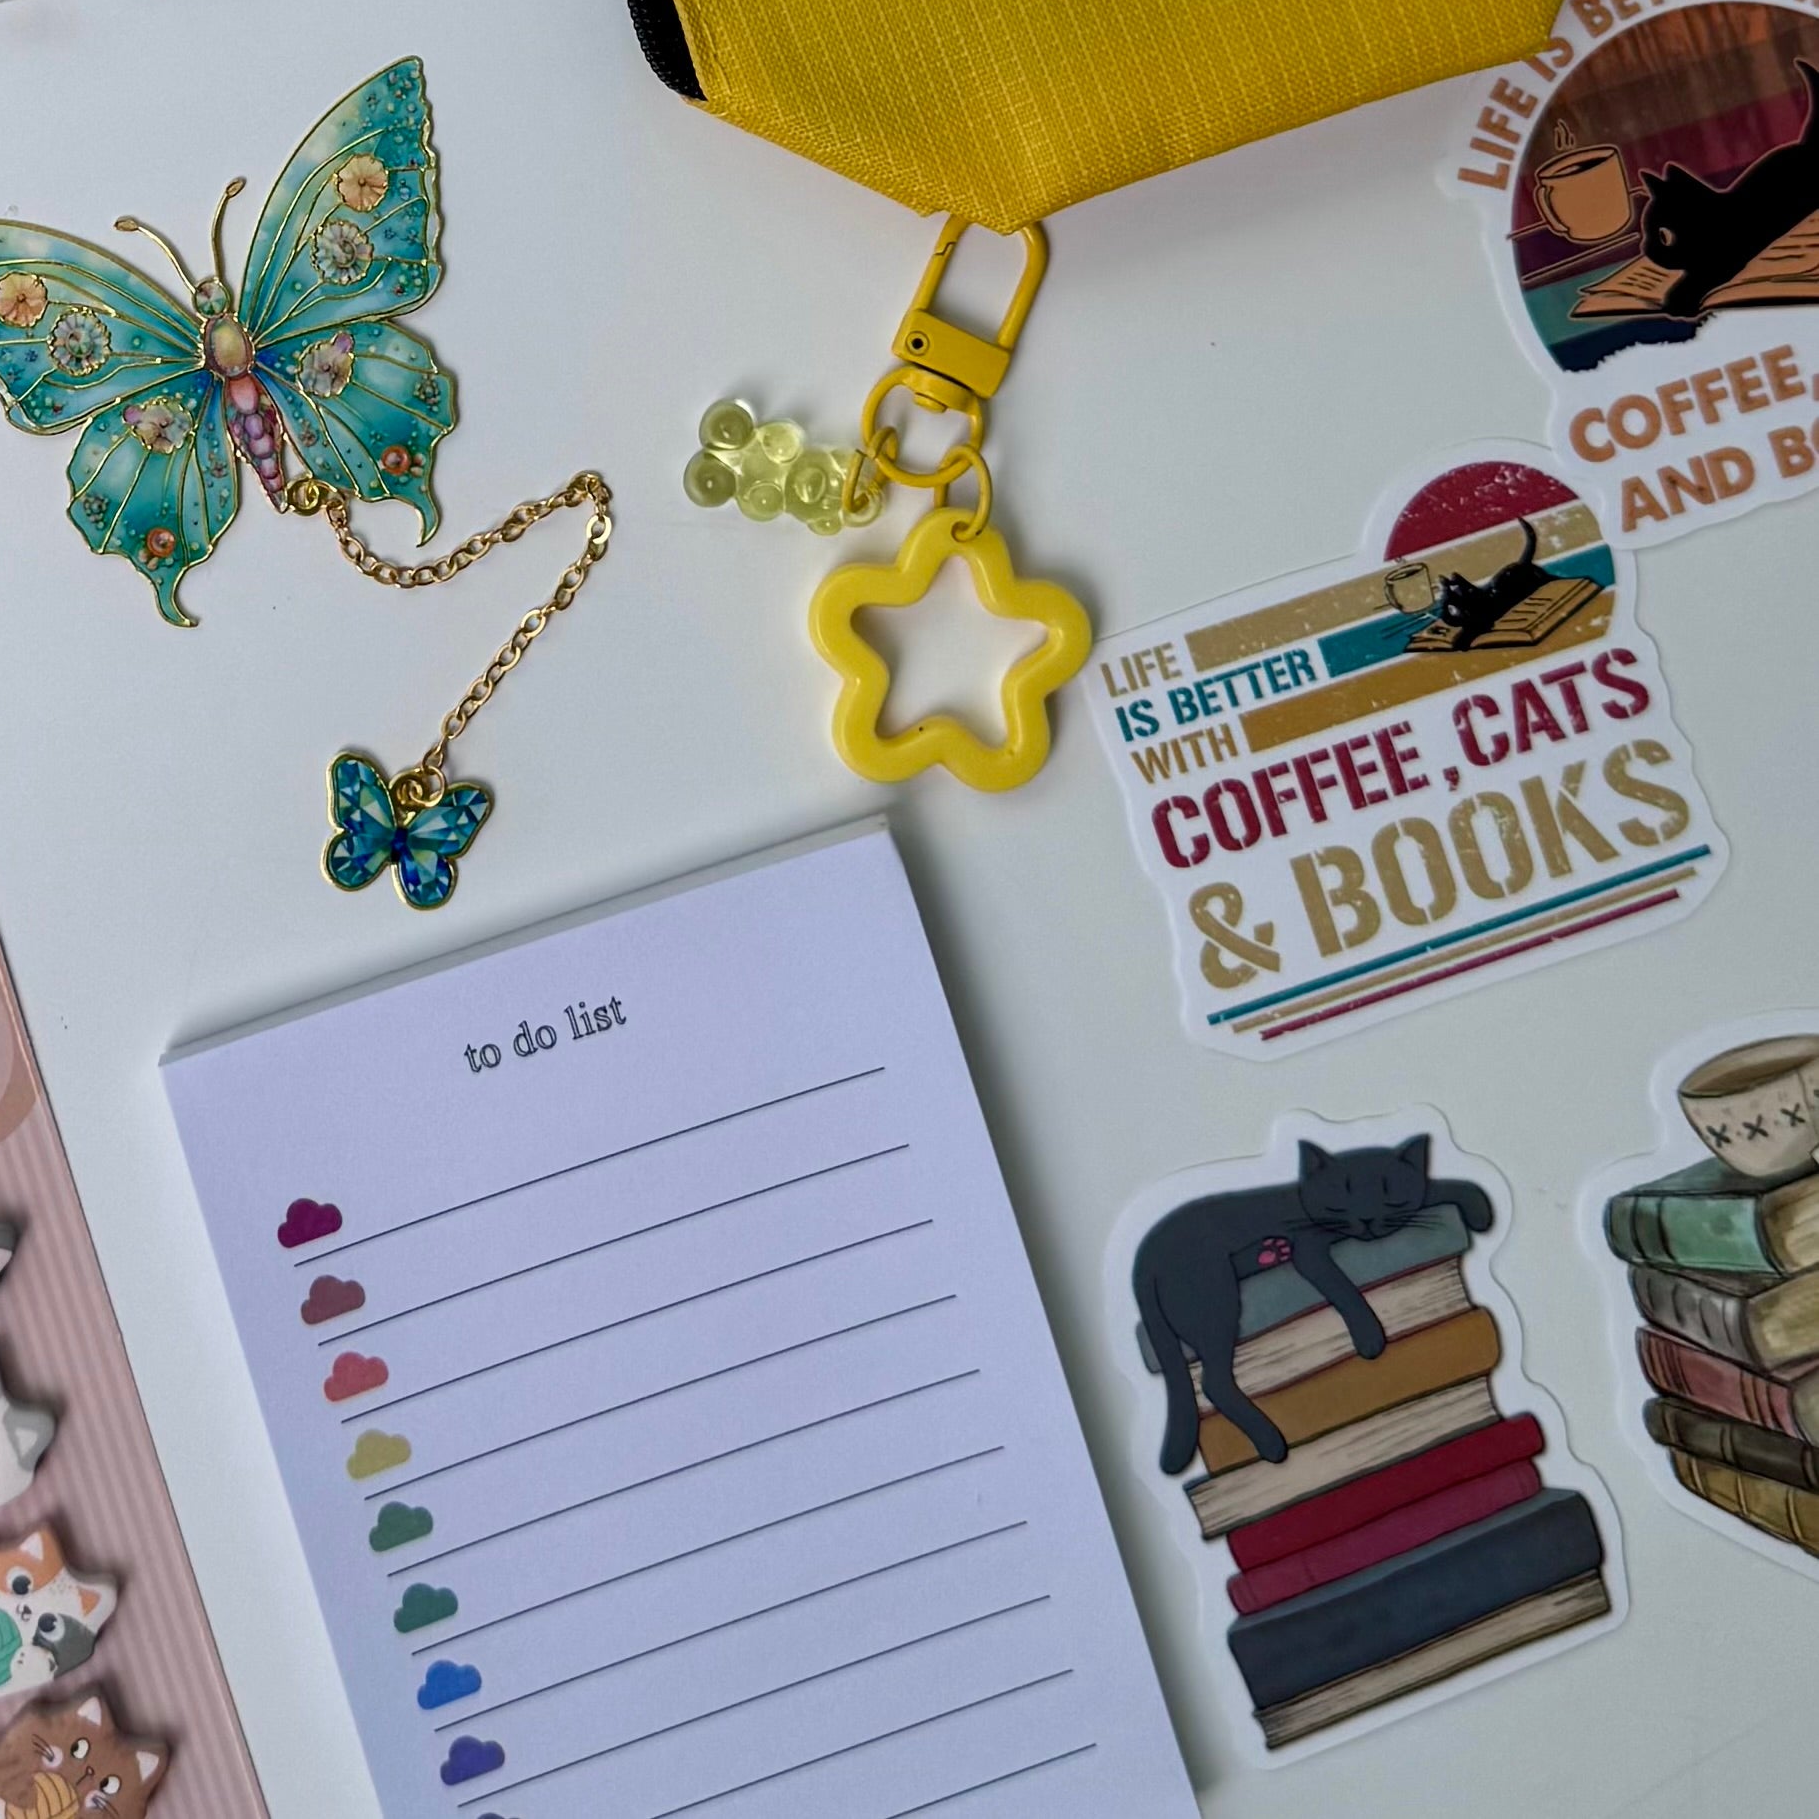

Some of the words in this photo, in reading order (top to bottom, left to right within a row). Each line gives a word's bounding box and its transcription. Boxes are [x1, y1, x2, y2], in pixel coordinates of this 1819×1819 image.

[1457, 76, 1539, 191] LIFE
[1622, 445, 1757, 533] AND
[1100, 641, 1182, 699] LIFE
[1114, 698, 1161, 742] IS
[1165, 648, 1319, 725] BETTER
[1130, 722, 1239, 786] WITH
[1188, 881, 1282, 990] &
[1289, 738, 1691, 958] BOOKS
[463, 1042, 502, 1073] to
[513, 1020, 558, 1058] do
[563, 995, 628, 1041] list
